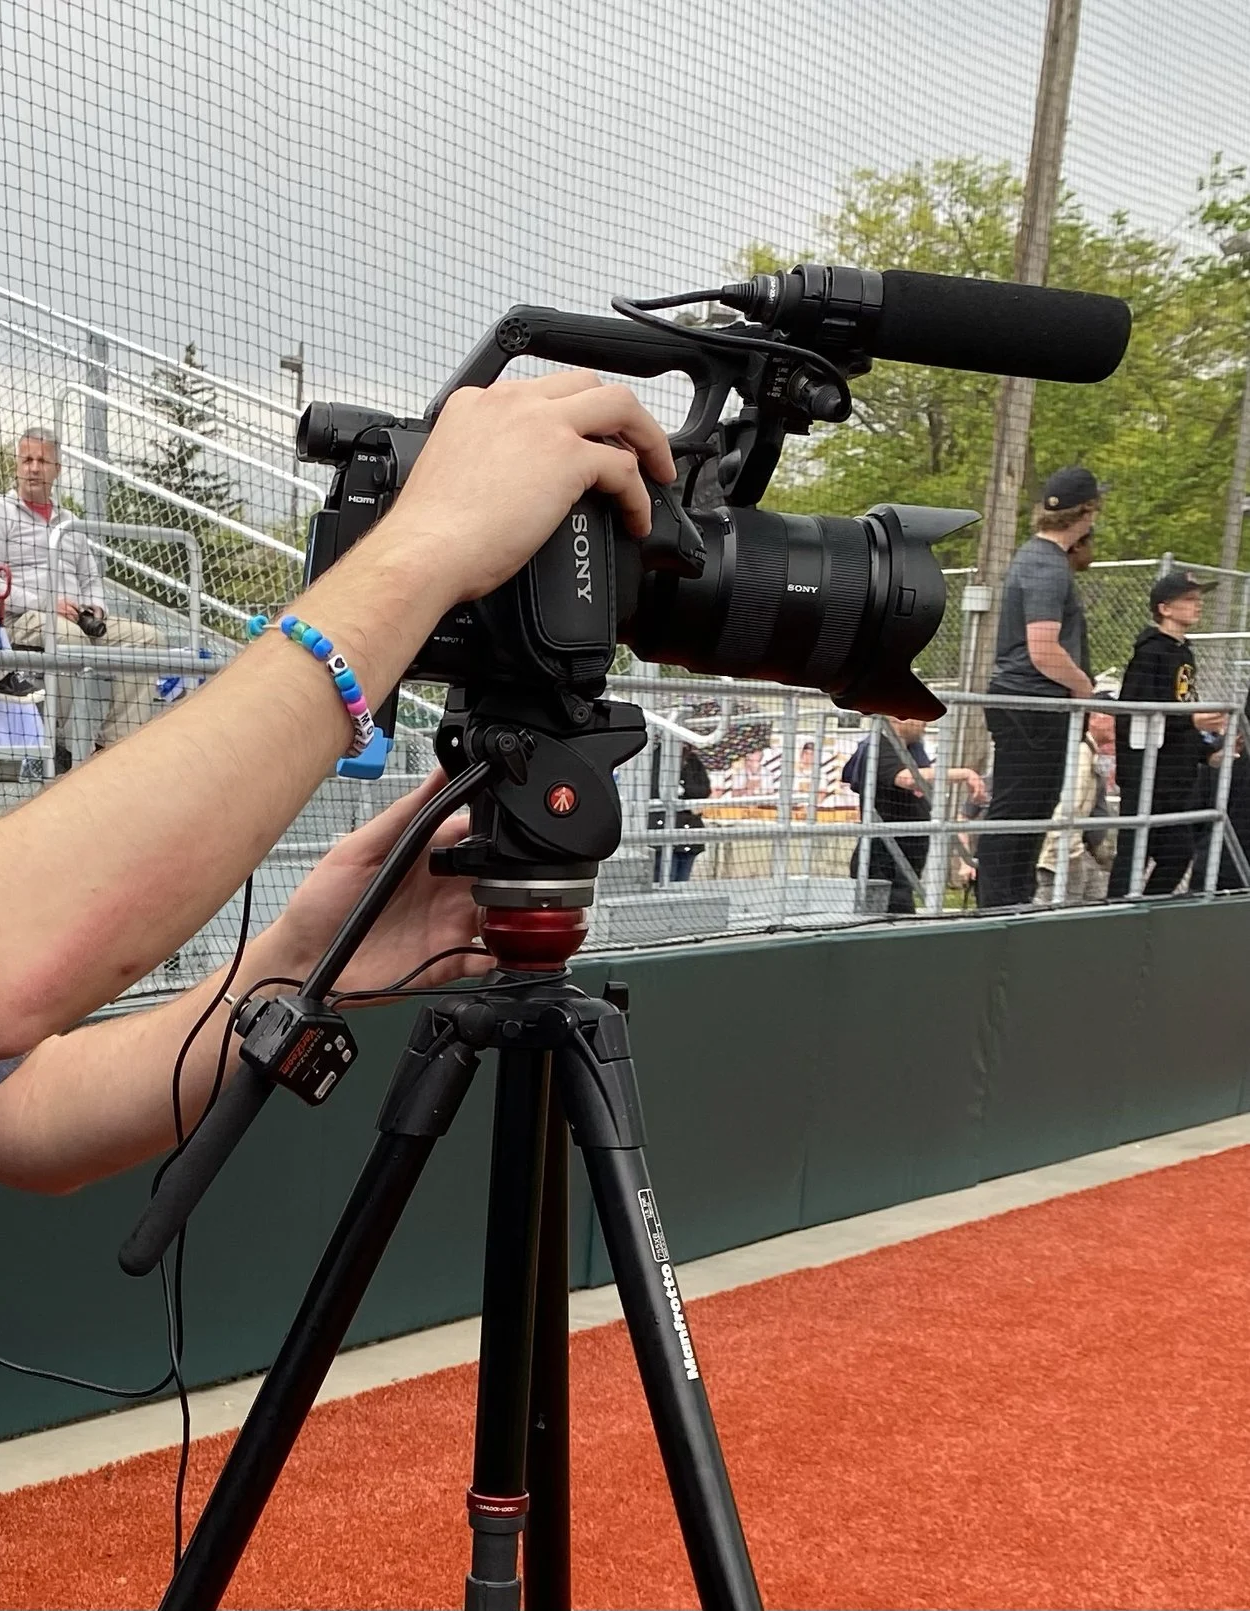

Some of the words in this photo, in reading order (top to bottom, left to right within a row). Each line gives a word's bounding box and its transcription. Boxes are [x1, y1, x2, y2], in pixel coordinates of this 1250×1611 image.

[348, 495, 375, 504] HDMI
[572, 513, 592, 604] SONY
[787, 583, 818, 593] SONY
[661, 1263, 699, 1381] Manfrotto
